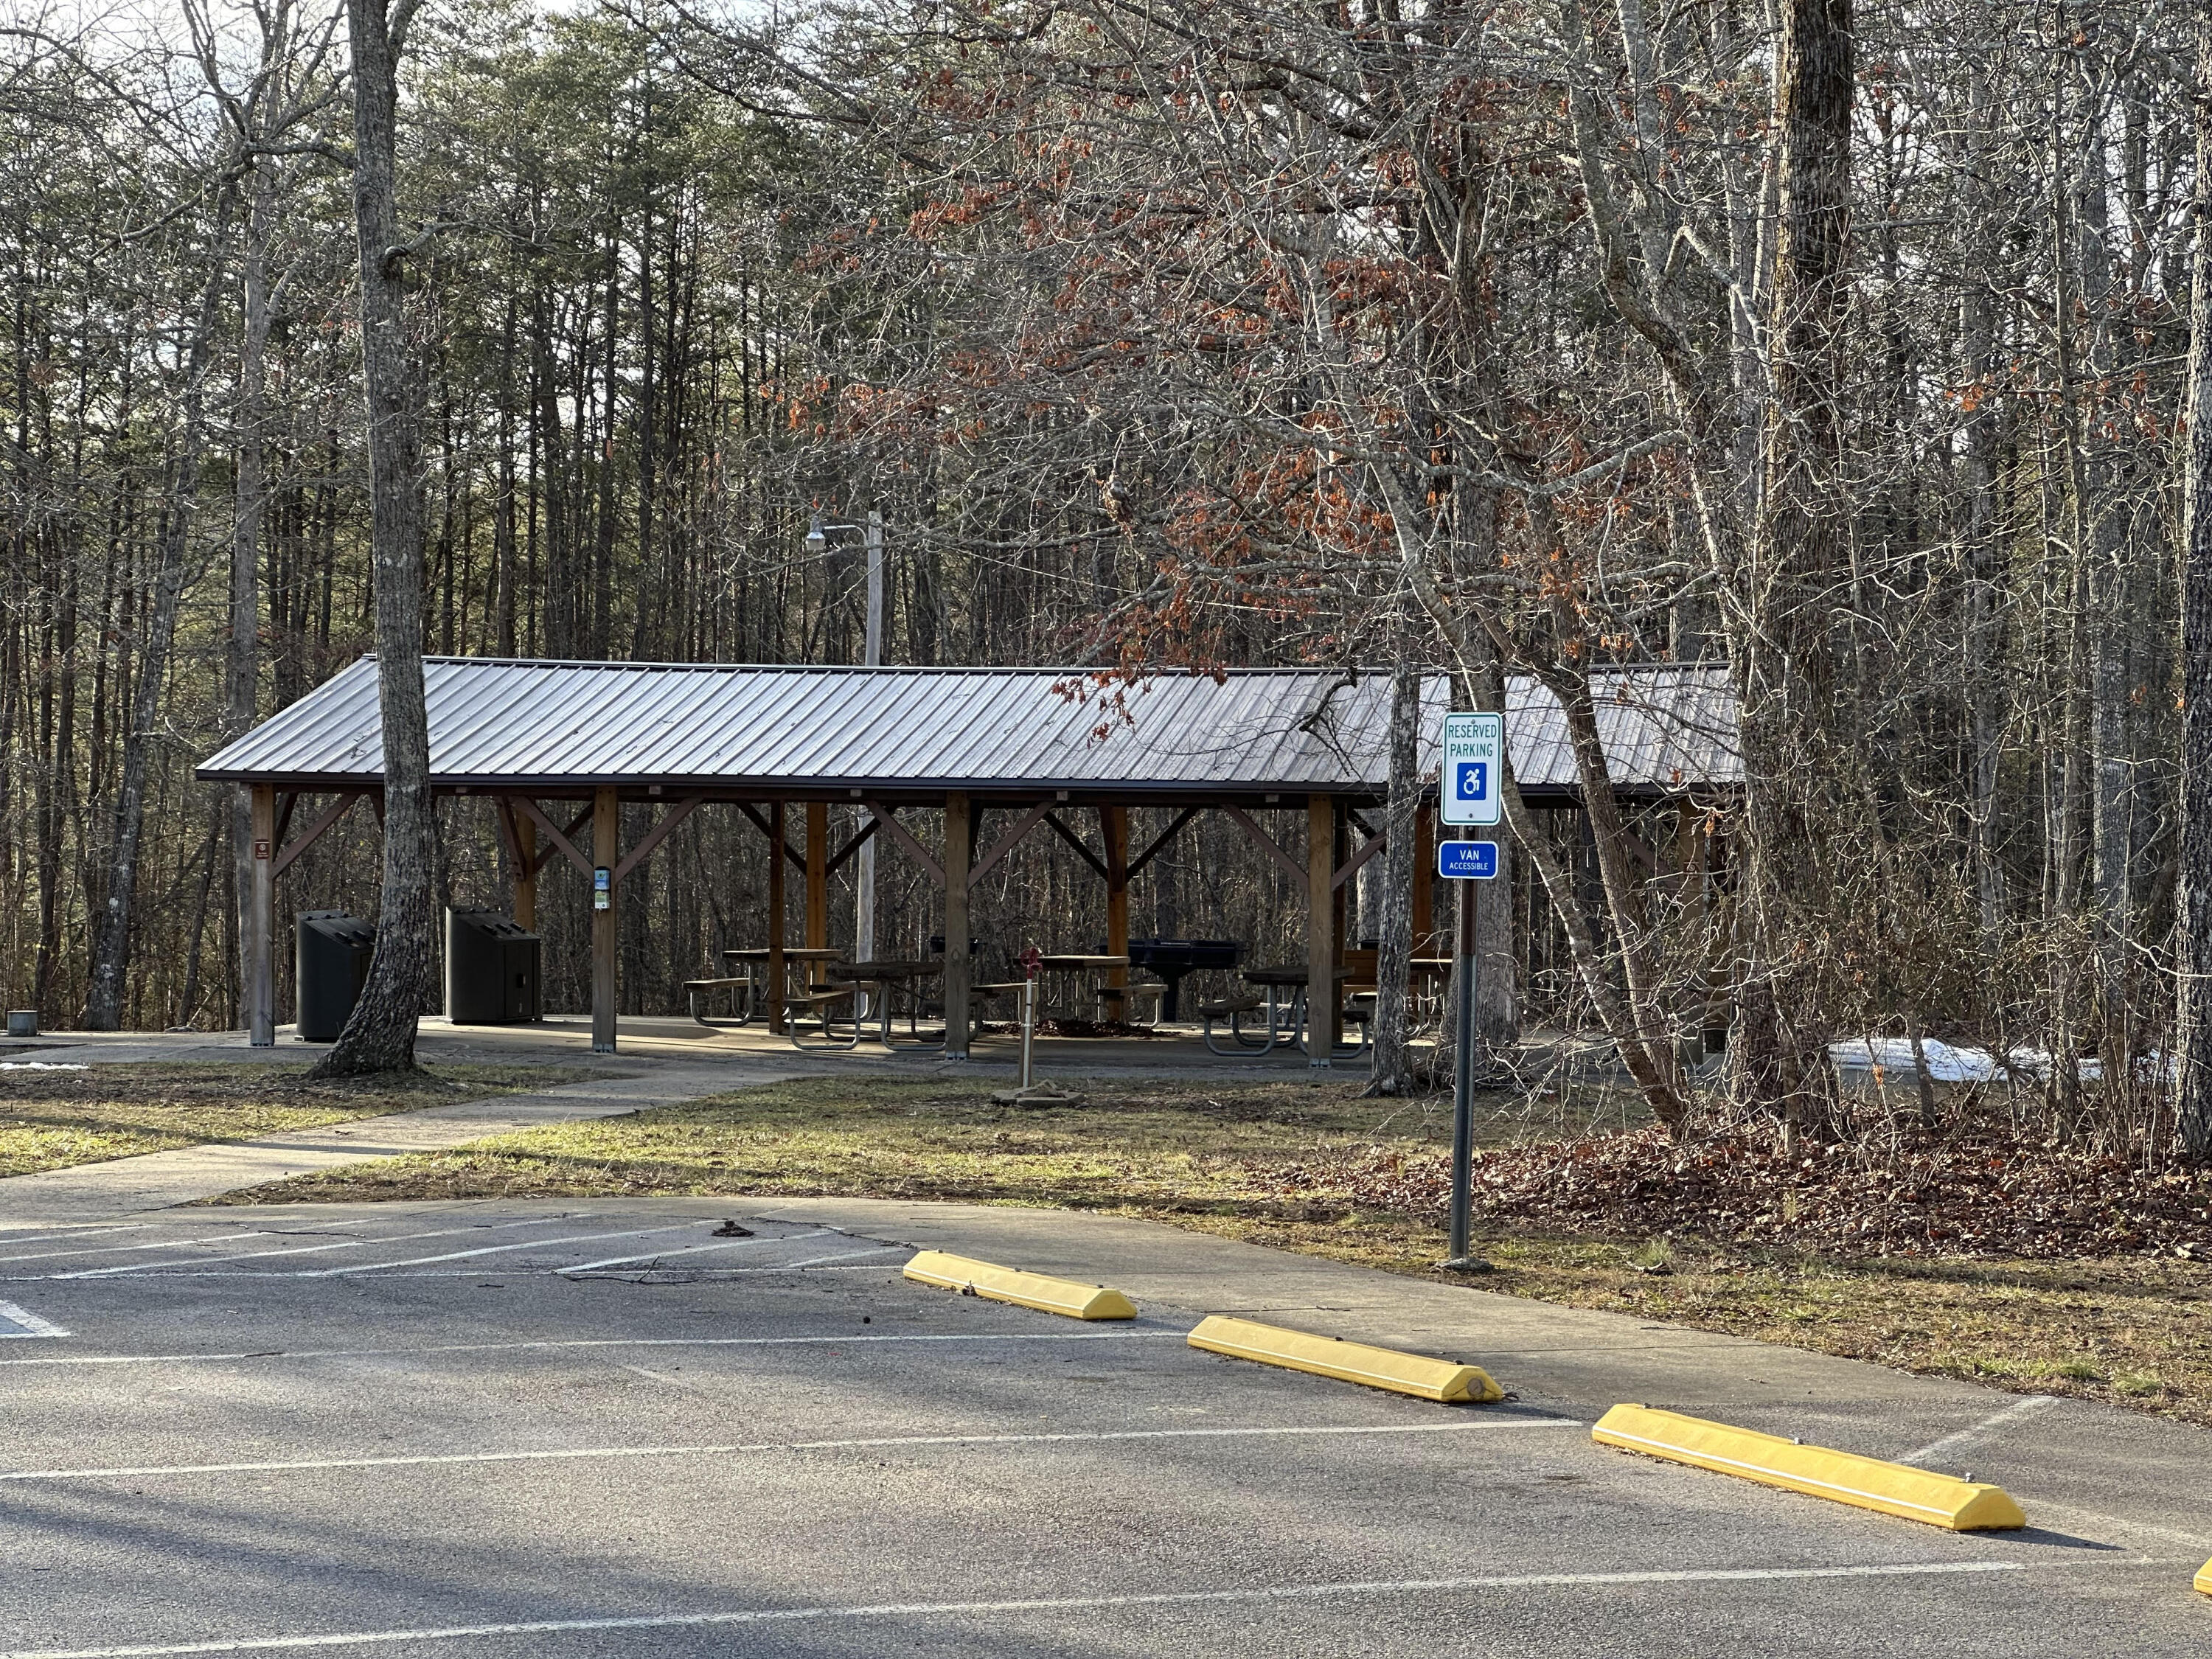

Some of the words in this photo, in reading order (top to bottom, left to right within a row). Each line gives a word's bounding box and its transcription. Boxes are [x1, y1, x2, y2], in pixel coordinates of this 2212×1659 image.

[1448, 724, 1497, 738] RESERVED
[1450, 743, 1493, 757] PARKING
[1459, 849, 1480, 860] VAN
[1449, 862, 1489, 870] ACCESSIBLE
